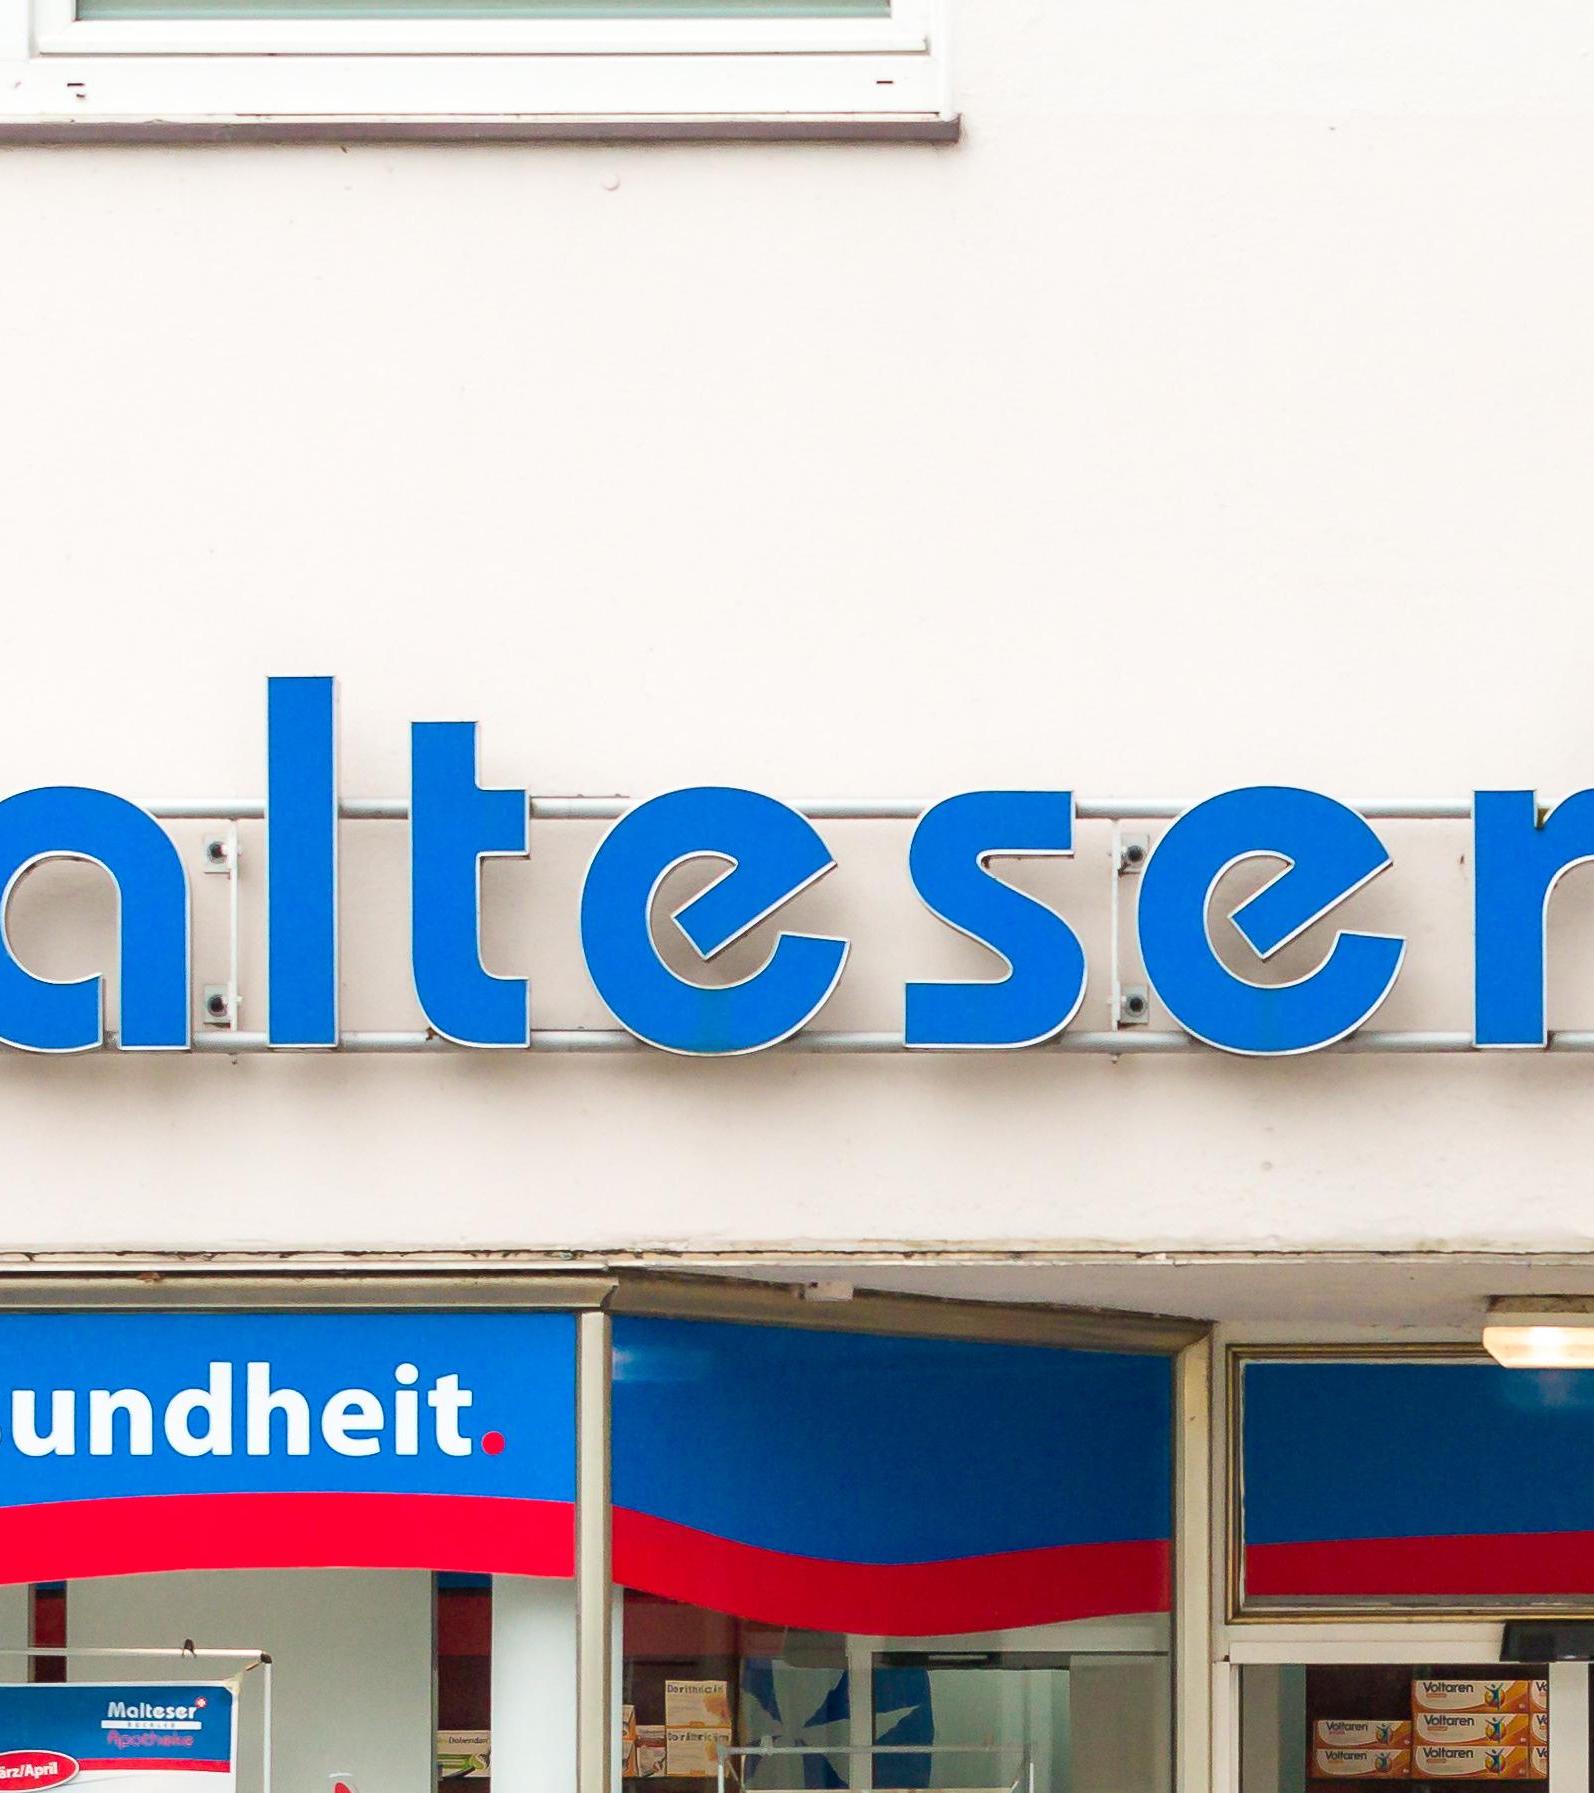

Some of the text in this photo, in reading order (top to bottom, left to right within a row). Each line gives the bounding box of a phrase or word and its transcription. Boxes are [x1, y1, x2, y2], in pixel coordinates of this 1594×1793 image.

[1422, 1682, 1474, 1694] Voltaren
[107, 1701, 198, 1720] Malteser
[1325, 1721, 1369, 1733] Voltaren
[1424, 1714, 1475, 1728] Voltaren
[1325, 1750, 1368, 1761] Voltaren
[1422, 1747, 1474, 1760] Voltaren
